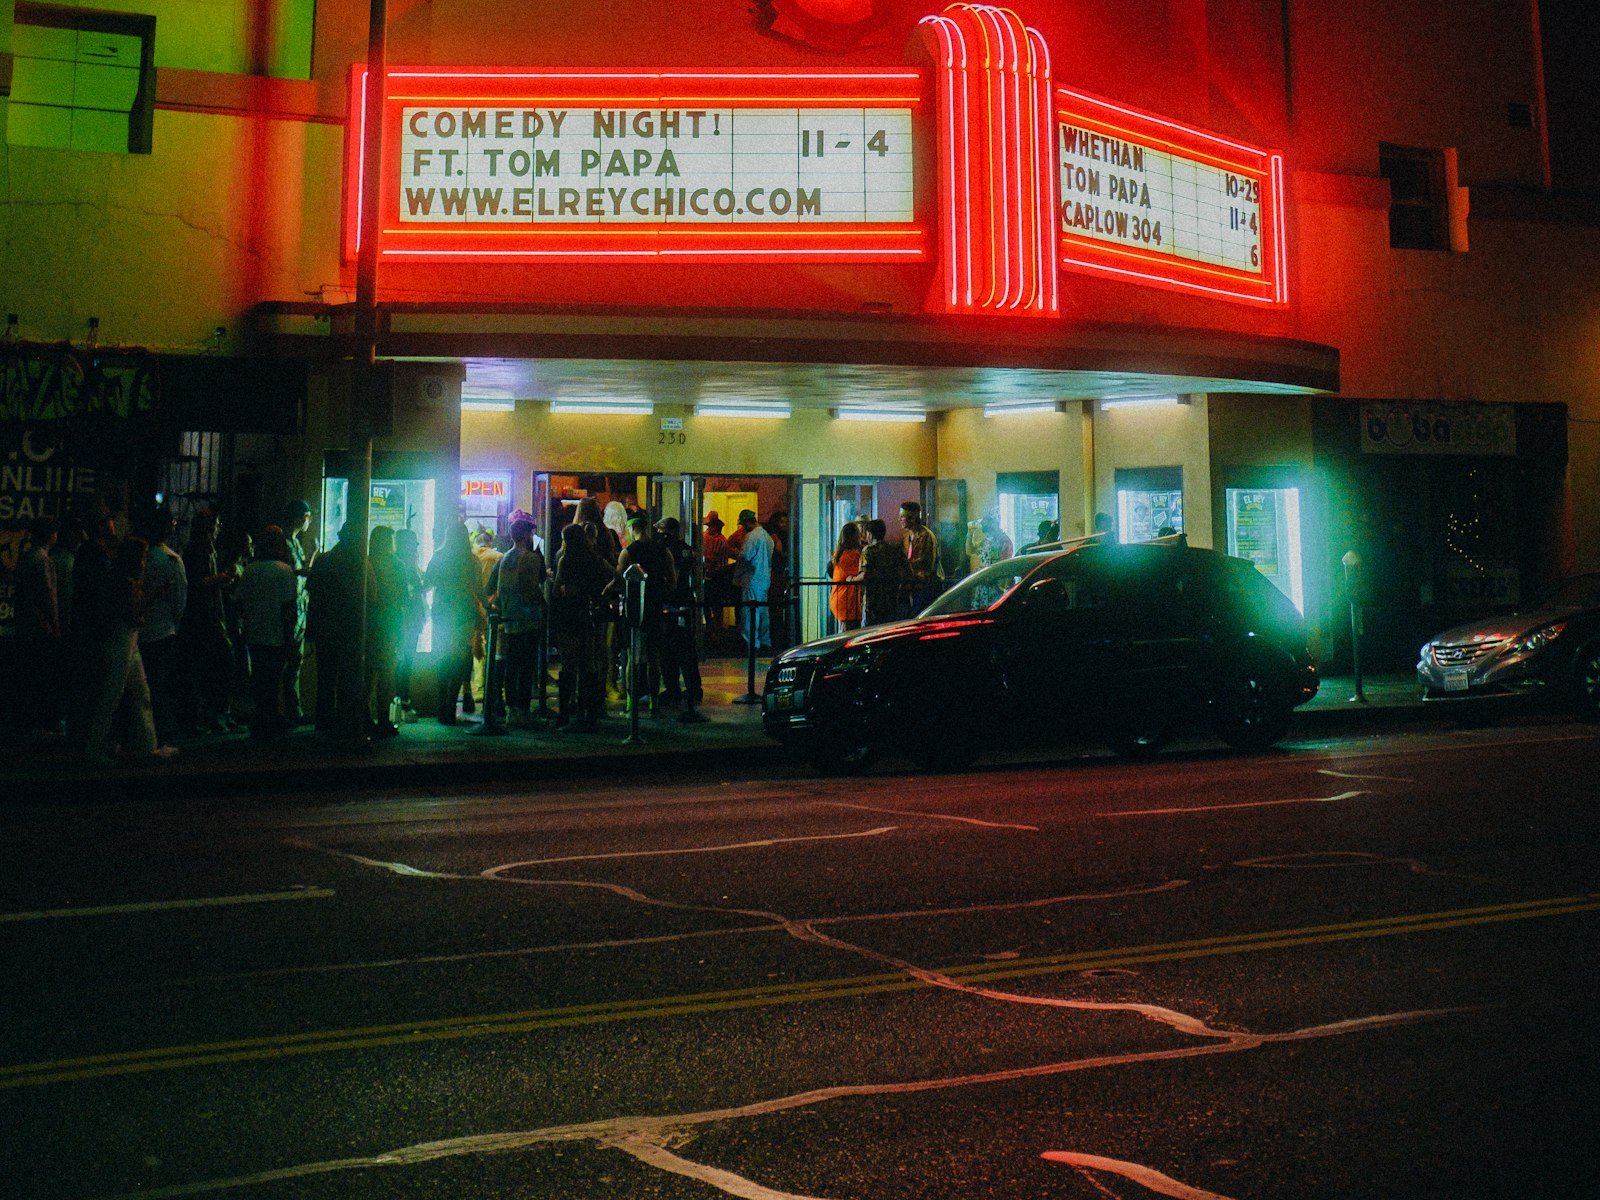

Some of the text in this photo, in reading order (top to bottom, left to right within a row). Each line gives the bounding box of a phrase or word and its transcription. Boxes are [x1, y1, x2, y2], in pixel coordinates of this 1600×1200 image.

[409, 111, 721, 139] COMEDY NIGHT!
[1062, 125, 1144, 172] WHETHAN
[413, 149, 681, 178] FT. TOM PAPA
[1064, 162, 1100, 197] TOM
[1109, 174, 1151, 209] PAPA
[406, 187, 823, 217] WWW.ELREYCHICO.COM
[1250, 244, 1258, 267] 6
[658, 432, 686, 445] 230
[373, 487, 391, 498] REY
